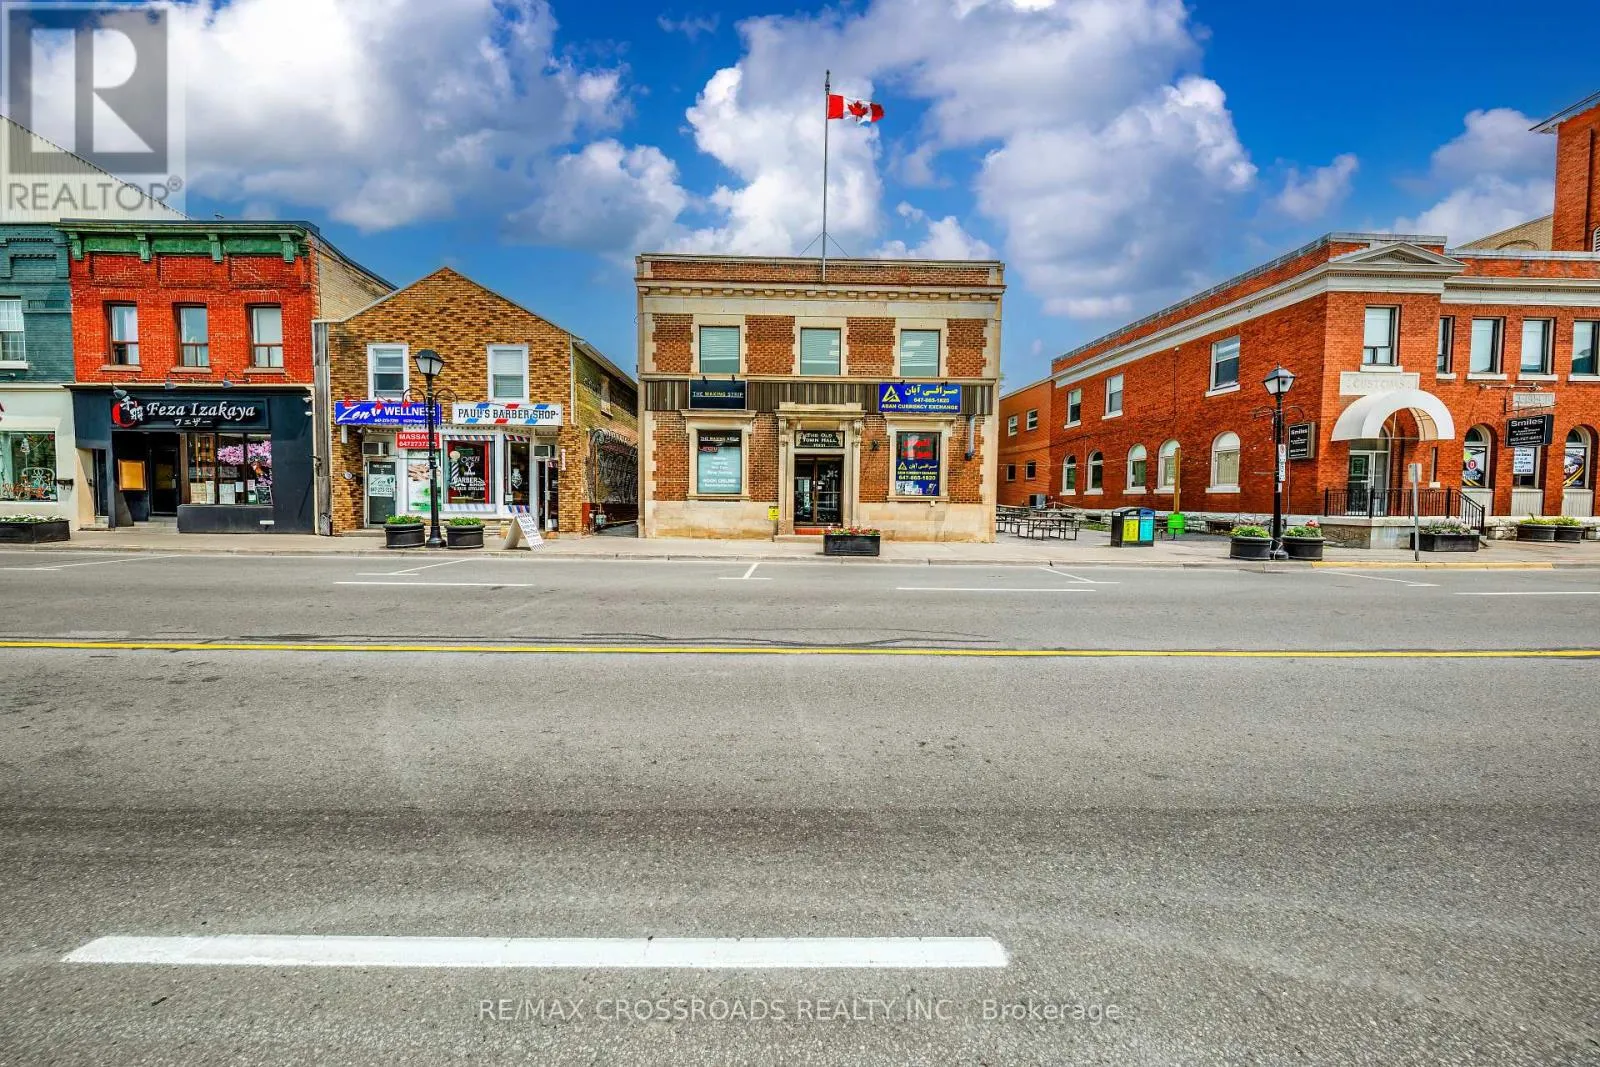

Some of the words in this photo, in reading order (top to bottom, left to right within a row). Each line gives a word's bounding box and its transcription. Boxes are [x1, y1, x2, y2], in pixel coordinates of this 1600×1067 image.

[146, 401, 186, 416] Feza
[190, 401, 255, 421] Izakaya
[337, 405, 371, 422] Zen
[458, 408, 490, 418] PAUL'S
[493, 409, 528, 419] BARBER
[1511, 418, 1544, 427] Smiles
